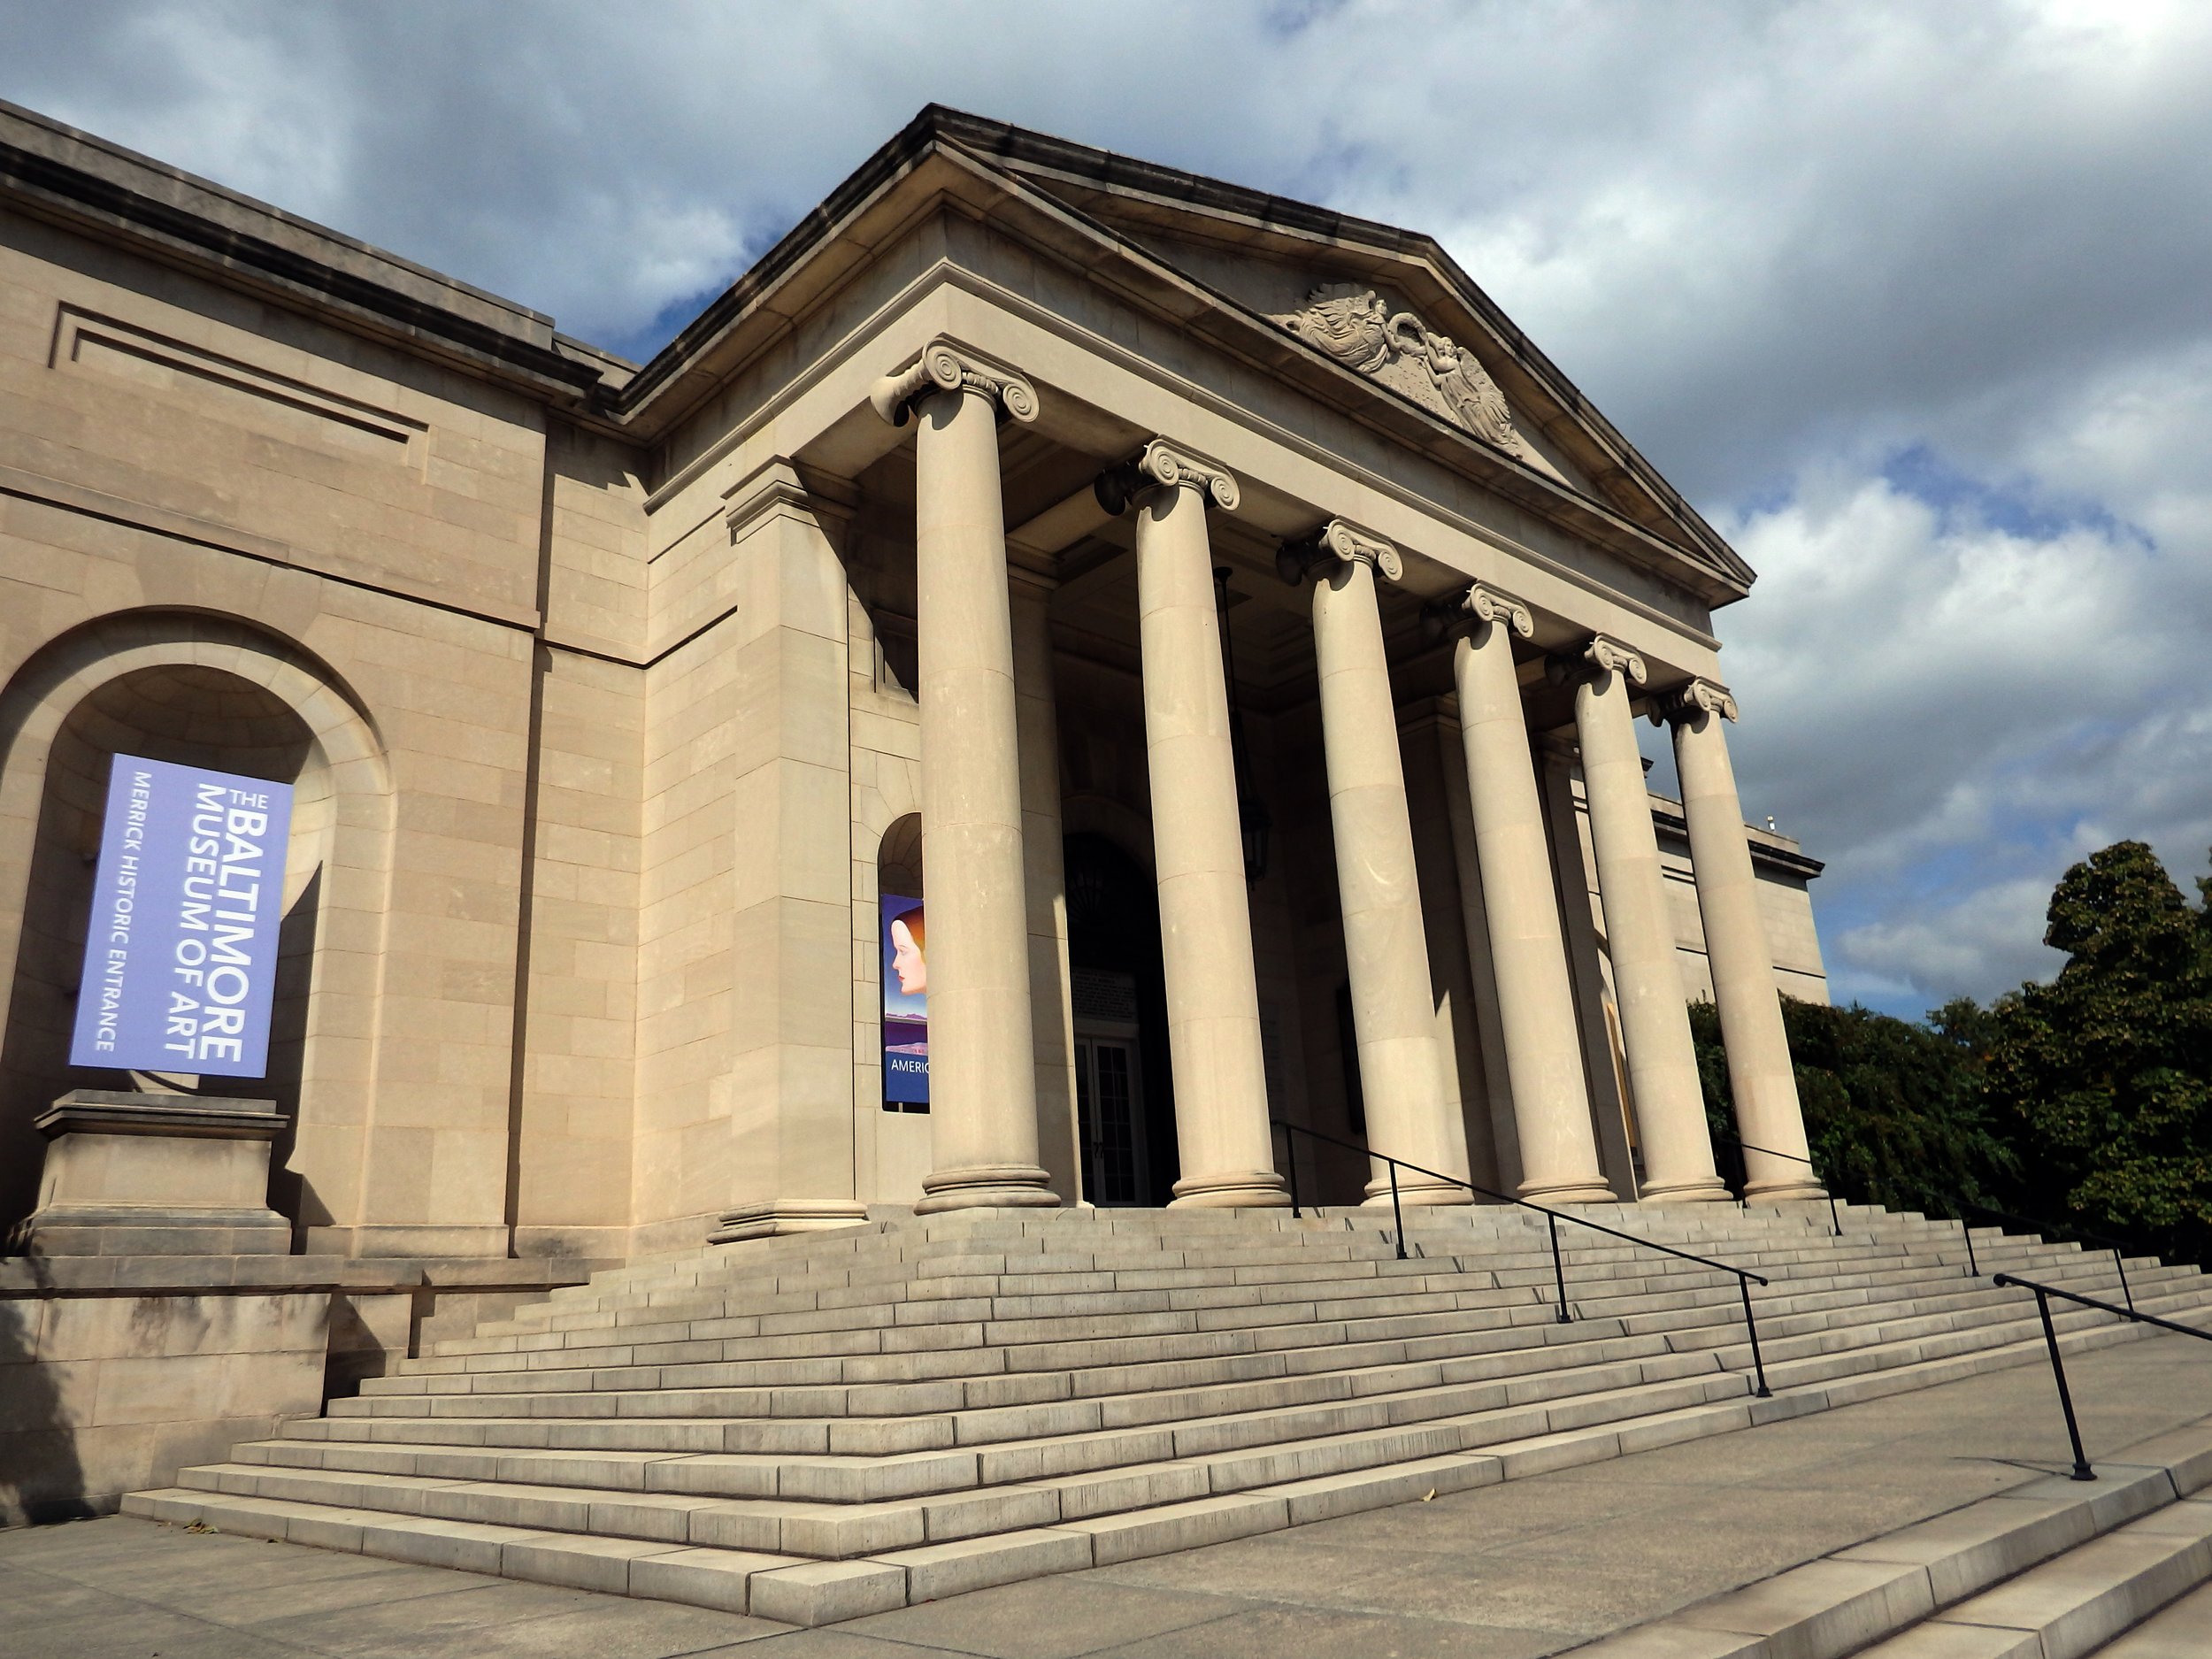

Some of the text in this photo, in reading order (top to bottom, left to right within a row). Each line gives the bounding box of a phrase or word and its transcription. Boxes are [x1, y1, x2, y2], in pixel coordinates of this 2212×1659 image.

[96, 772, 151, 1051] MERRICK HISTORIC ENTRANCE
[165, 784, 227, 1059] MUSEUM OF ART
[229, 789, 269, 809] THE
[199, 808, 268, 1062] BALTIMORE
